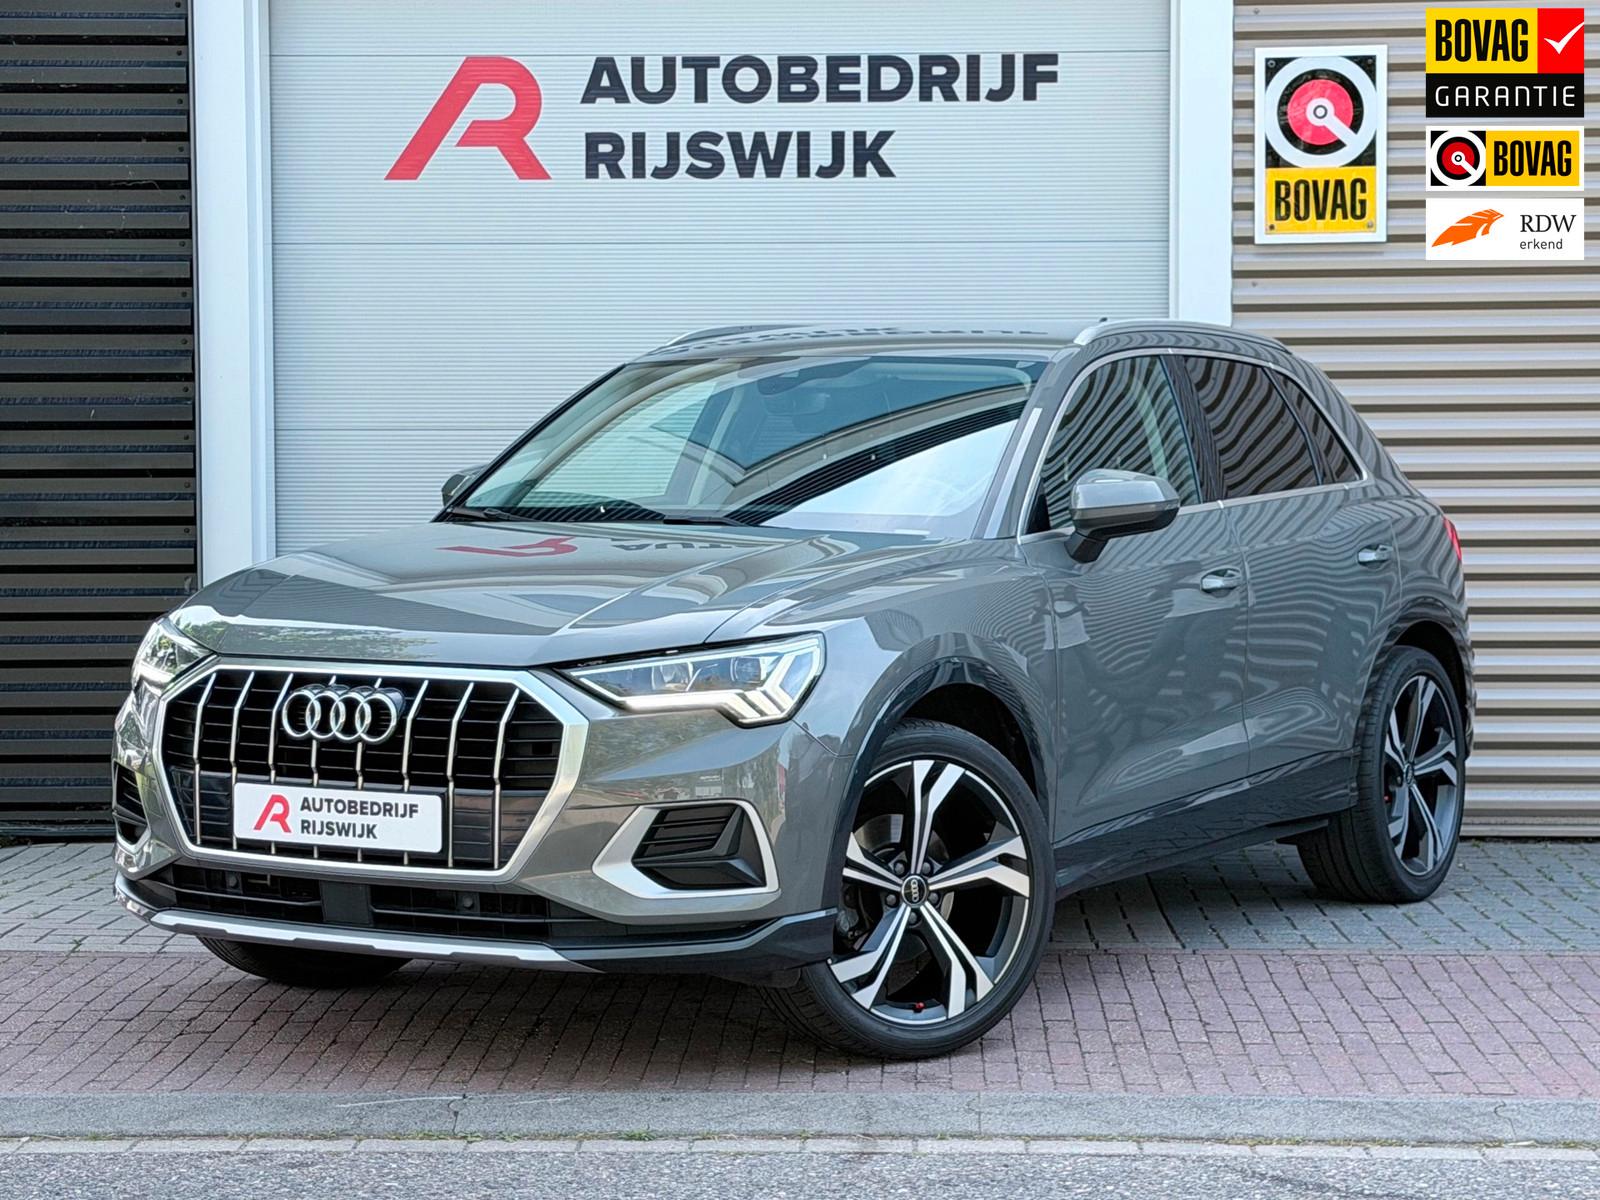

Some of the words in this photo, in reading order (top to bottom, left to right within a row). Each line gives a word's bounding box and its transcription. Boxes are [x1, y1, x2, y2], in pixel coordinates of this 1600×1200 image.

[581, 53, 1059, 104] AUTOBEDRIJF
[585, 130, 896, 180] RIJSWIJK
[1274, 177, 1367, 222] BOVAG
[300, 796, 419, 819] AUTOBEDRIJF
[300, 819, 378, 840] RIJSWIJK
